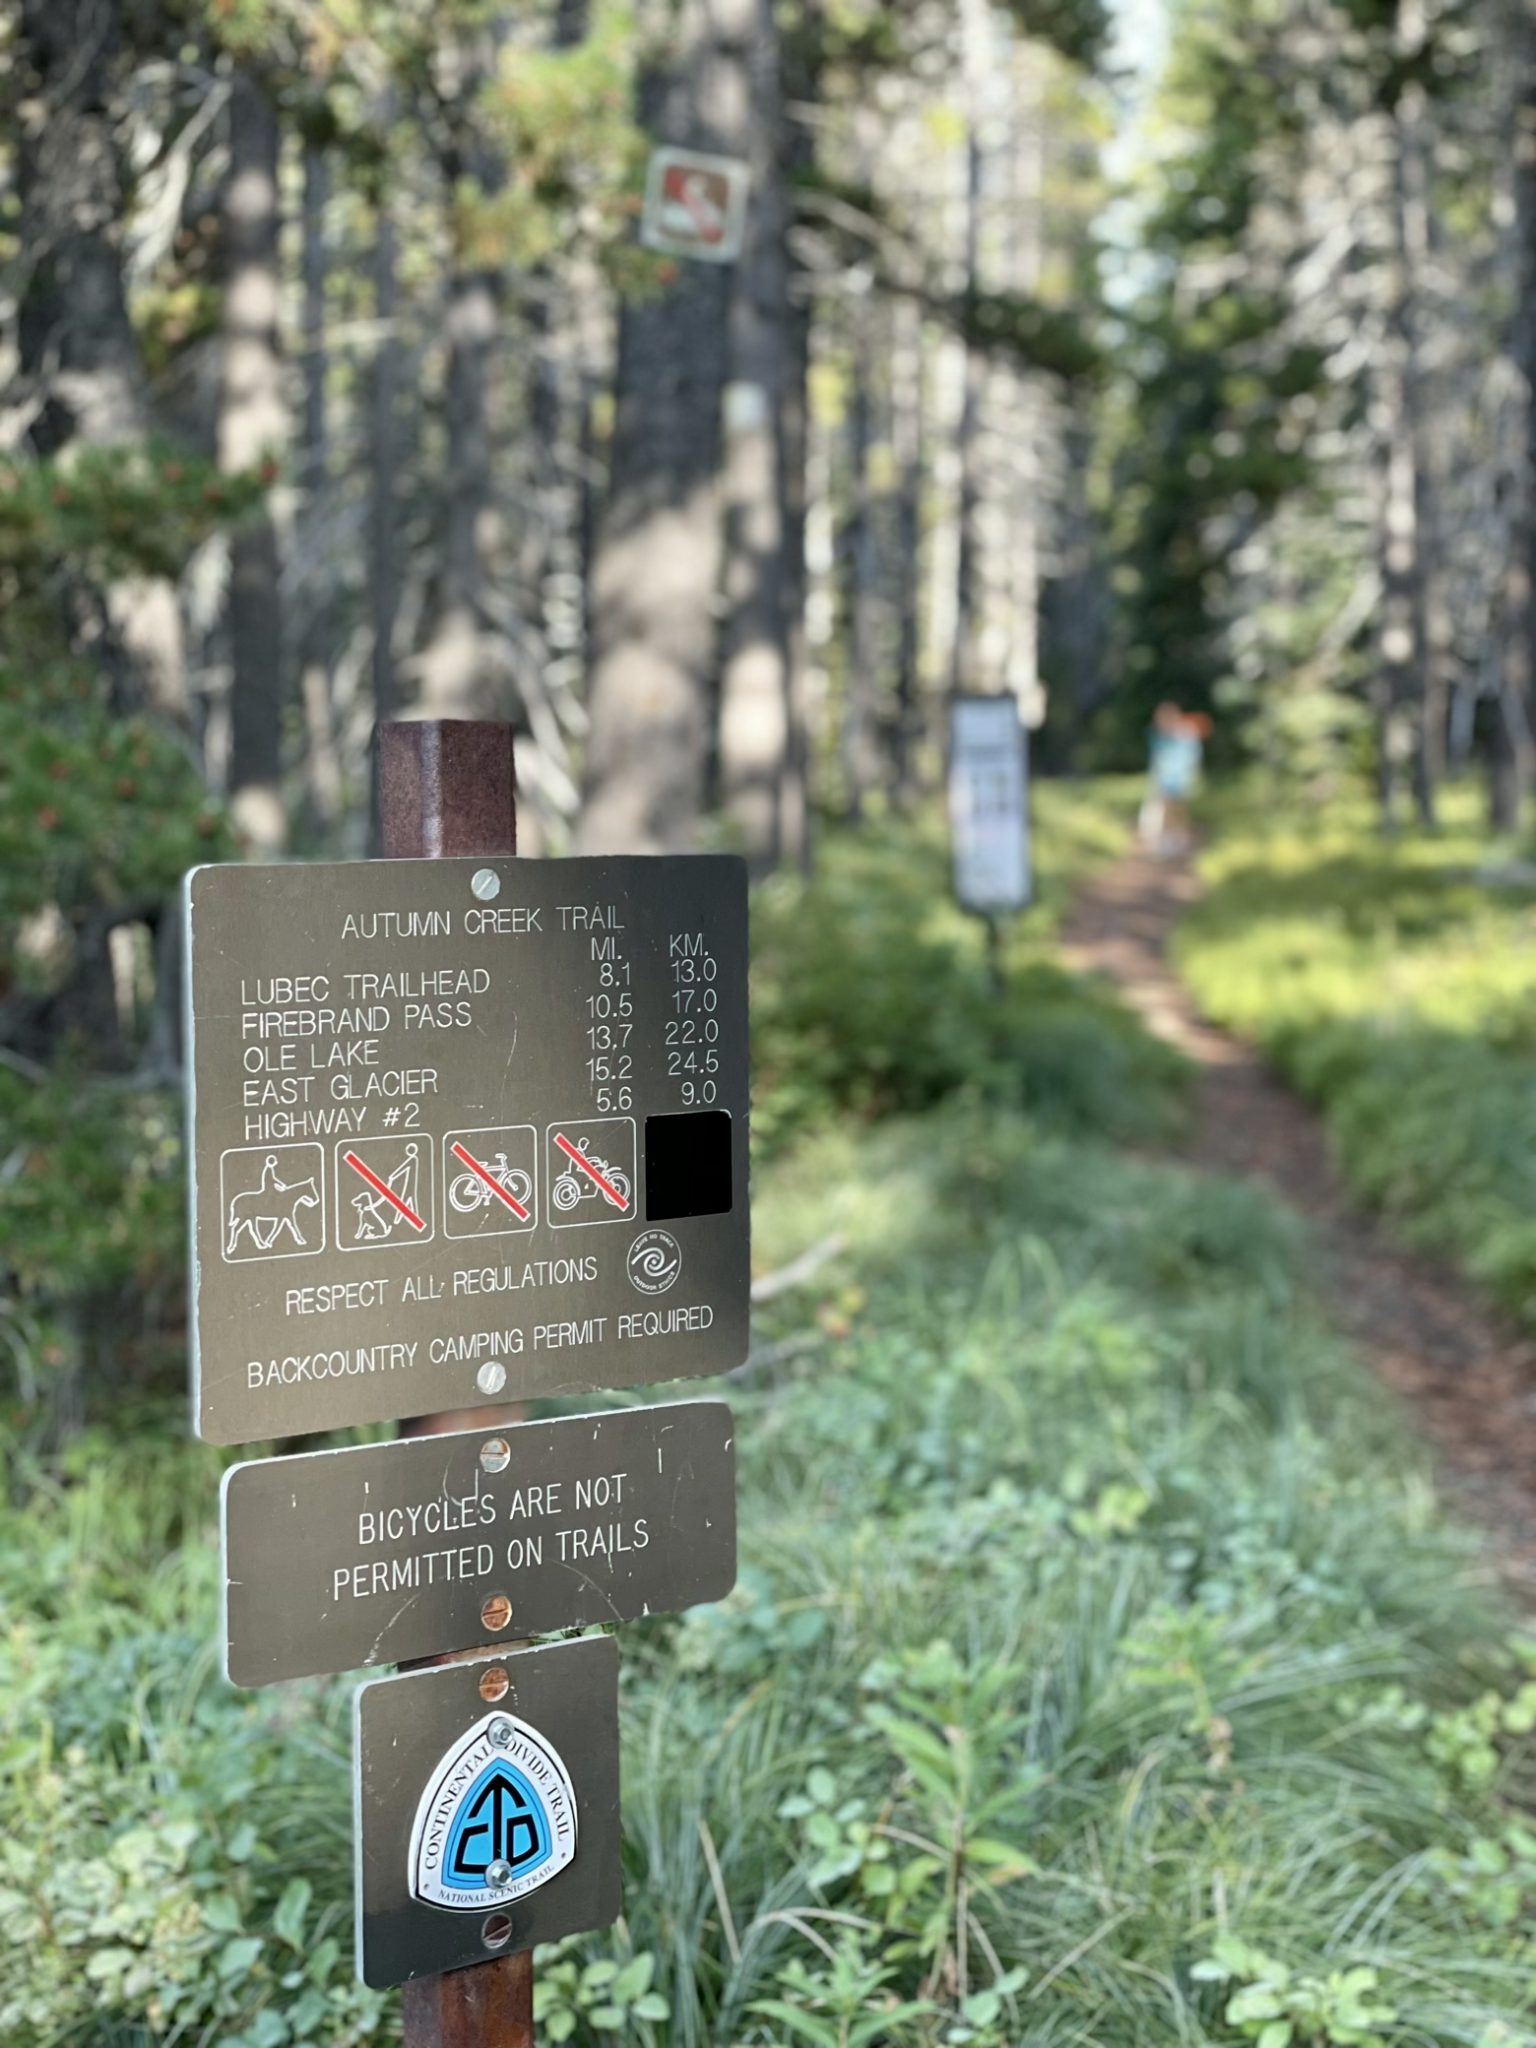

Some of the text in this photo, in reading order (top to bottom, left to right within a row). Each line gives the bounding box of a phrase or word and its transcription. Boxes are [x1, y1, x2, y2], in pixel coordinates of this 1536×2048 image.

[341, 905, 625, 939] AUTUMN CREEK TRAIL
[591, 934, 710, 961] MI. KM.
[241, 958, 717, 1006] LUBEC TRAILHEAD 8.1 13.0
[242, 991, 718, 1039] FIREBRAND PASS 10.5 17.0
[243, 1021, 719, 1073] OLE LAKE 13.7 22.0
[243, 1053, 719, 1107] EAST GLACIER 15.2 24.5
[244, 1081, 717, 1142] HIGHWAY #2 5.6 9.0
[634, 1236, 648, 1252] LEAVE
[286, 1257, 598, 1316] RESPECT ALL REGULATIONS
[633, 1275, 657, 1290] OUTDOOR
[247, 1305, 714, 1388] BACKCOUNTRY CAMPING PERMIT REQUIRED
[359, 1473, 627, 1545] BICYCLES ARE NOT
[333, 1519, 650, 1601] PERMITTED ON TRAILS
[425, 1740, 570, 1870] CONTINENTAL DIVIDE TRAIL
[438, 1865, 555, 1904] NATIONAL SCENIC TRAIL
